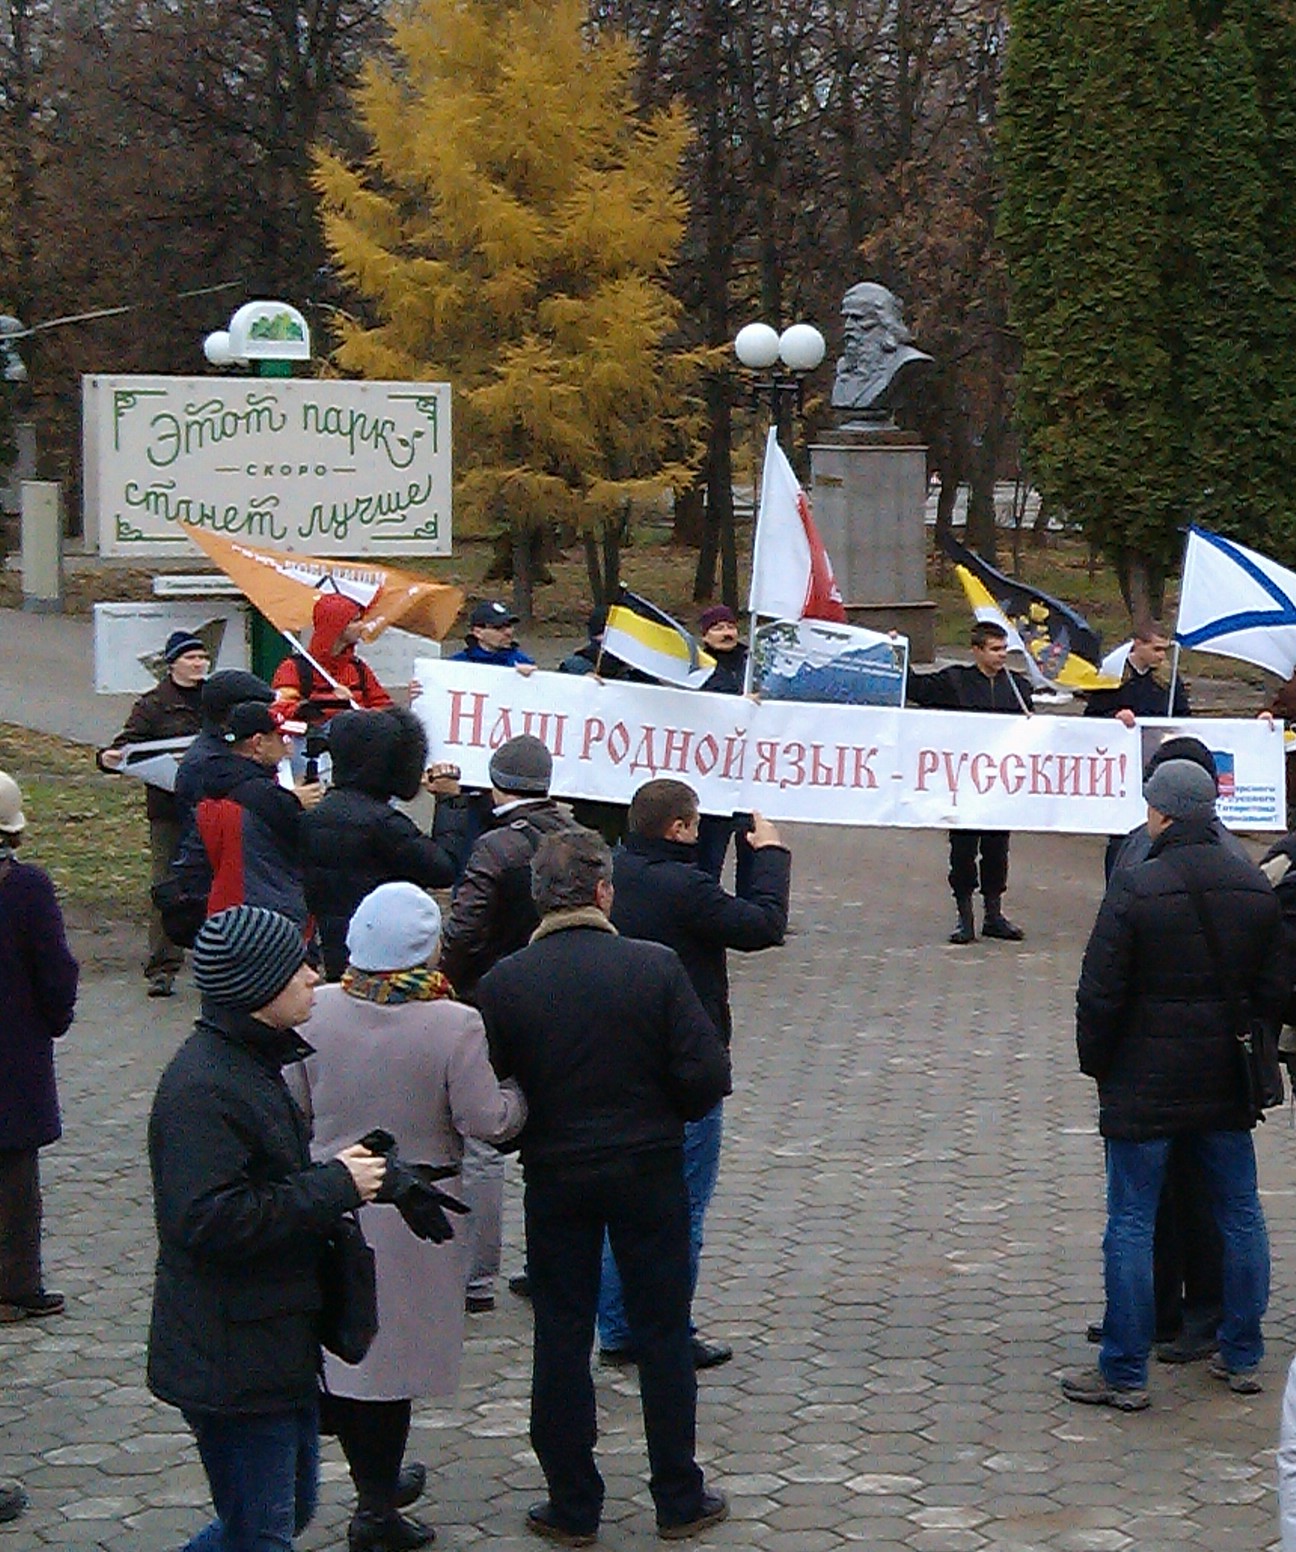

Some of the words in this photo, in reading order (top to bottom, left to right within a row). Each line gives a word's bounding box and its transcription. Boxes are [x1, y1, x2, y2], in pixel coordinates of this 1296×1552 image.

[147, 393, 287, 467] Этот
[302, 403, 424, 468] парк
[124, 479, 288, 541] станет
[298, 473, 432, 541] лучше
